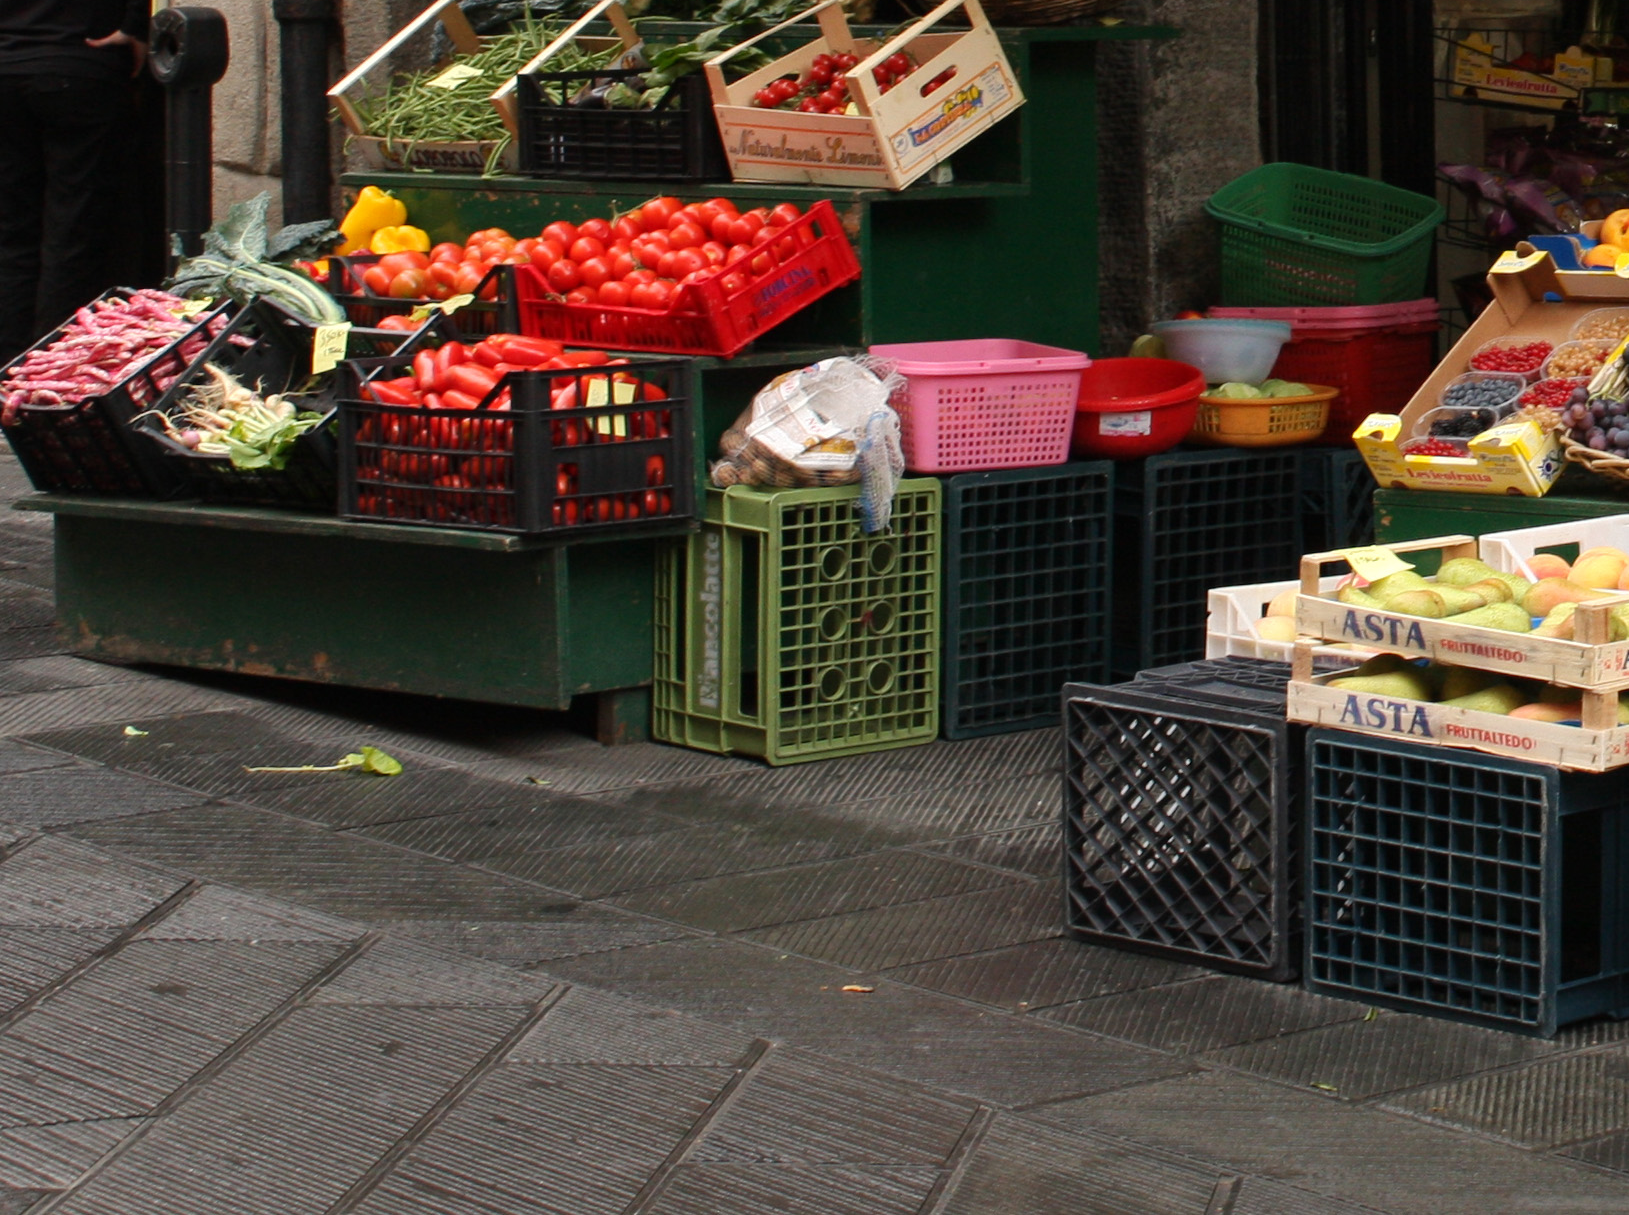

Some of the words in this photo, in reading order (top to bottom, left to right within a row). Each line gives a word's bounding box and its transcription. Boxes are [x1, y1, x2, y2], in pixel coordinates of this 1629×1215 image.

[1342, 609, 1427, 651] ASTA
[1440, 638, 1523, 664] FRUTTALTEDO
[1339, 694, 1434, 738] ASTA
[1446, 724, 1533, 750] FRUTTALTEDO
